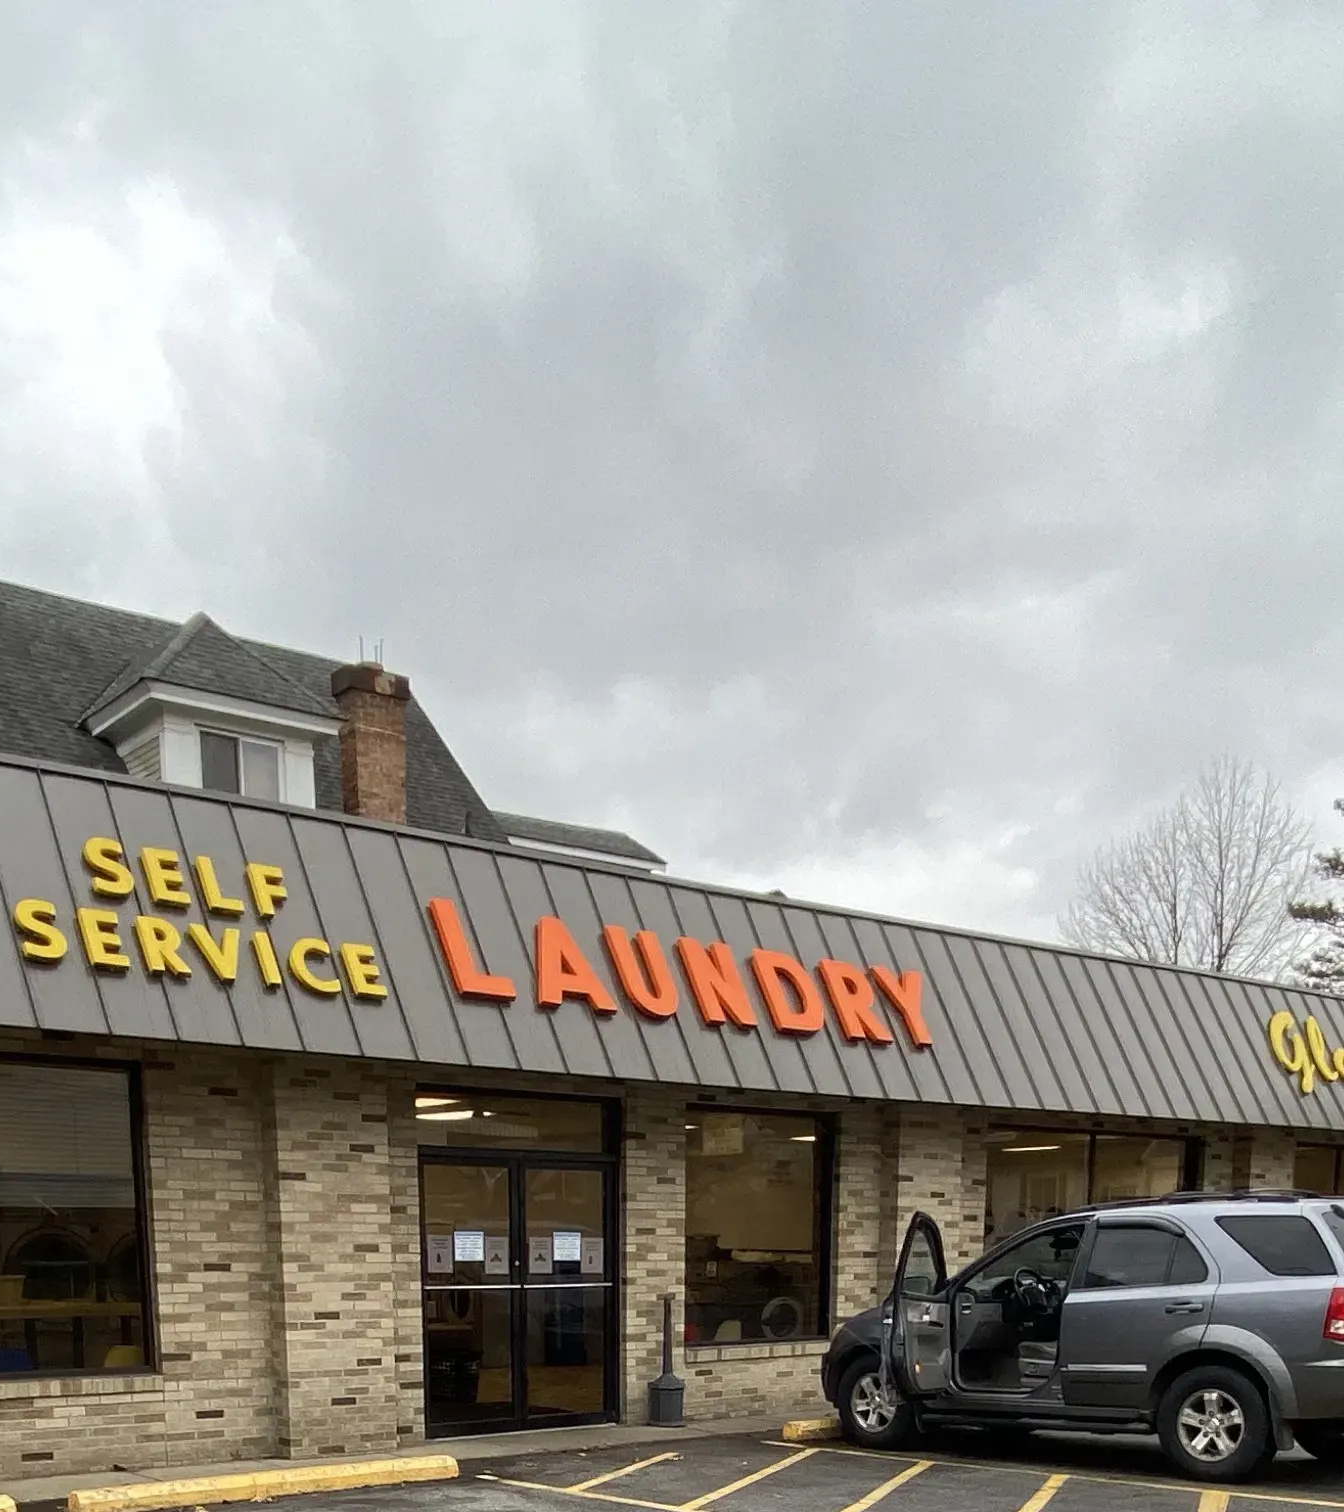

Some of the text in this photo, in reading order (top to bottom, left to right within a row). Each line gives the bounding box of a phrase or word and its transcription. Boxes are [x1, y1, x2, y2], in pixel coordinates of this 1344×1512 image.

[82, 836, 288, 919] SELF
[14, 898, 389, 1002] SERVICE
[429, 897, 934, 1049] LAUNDRY
